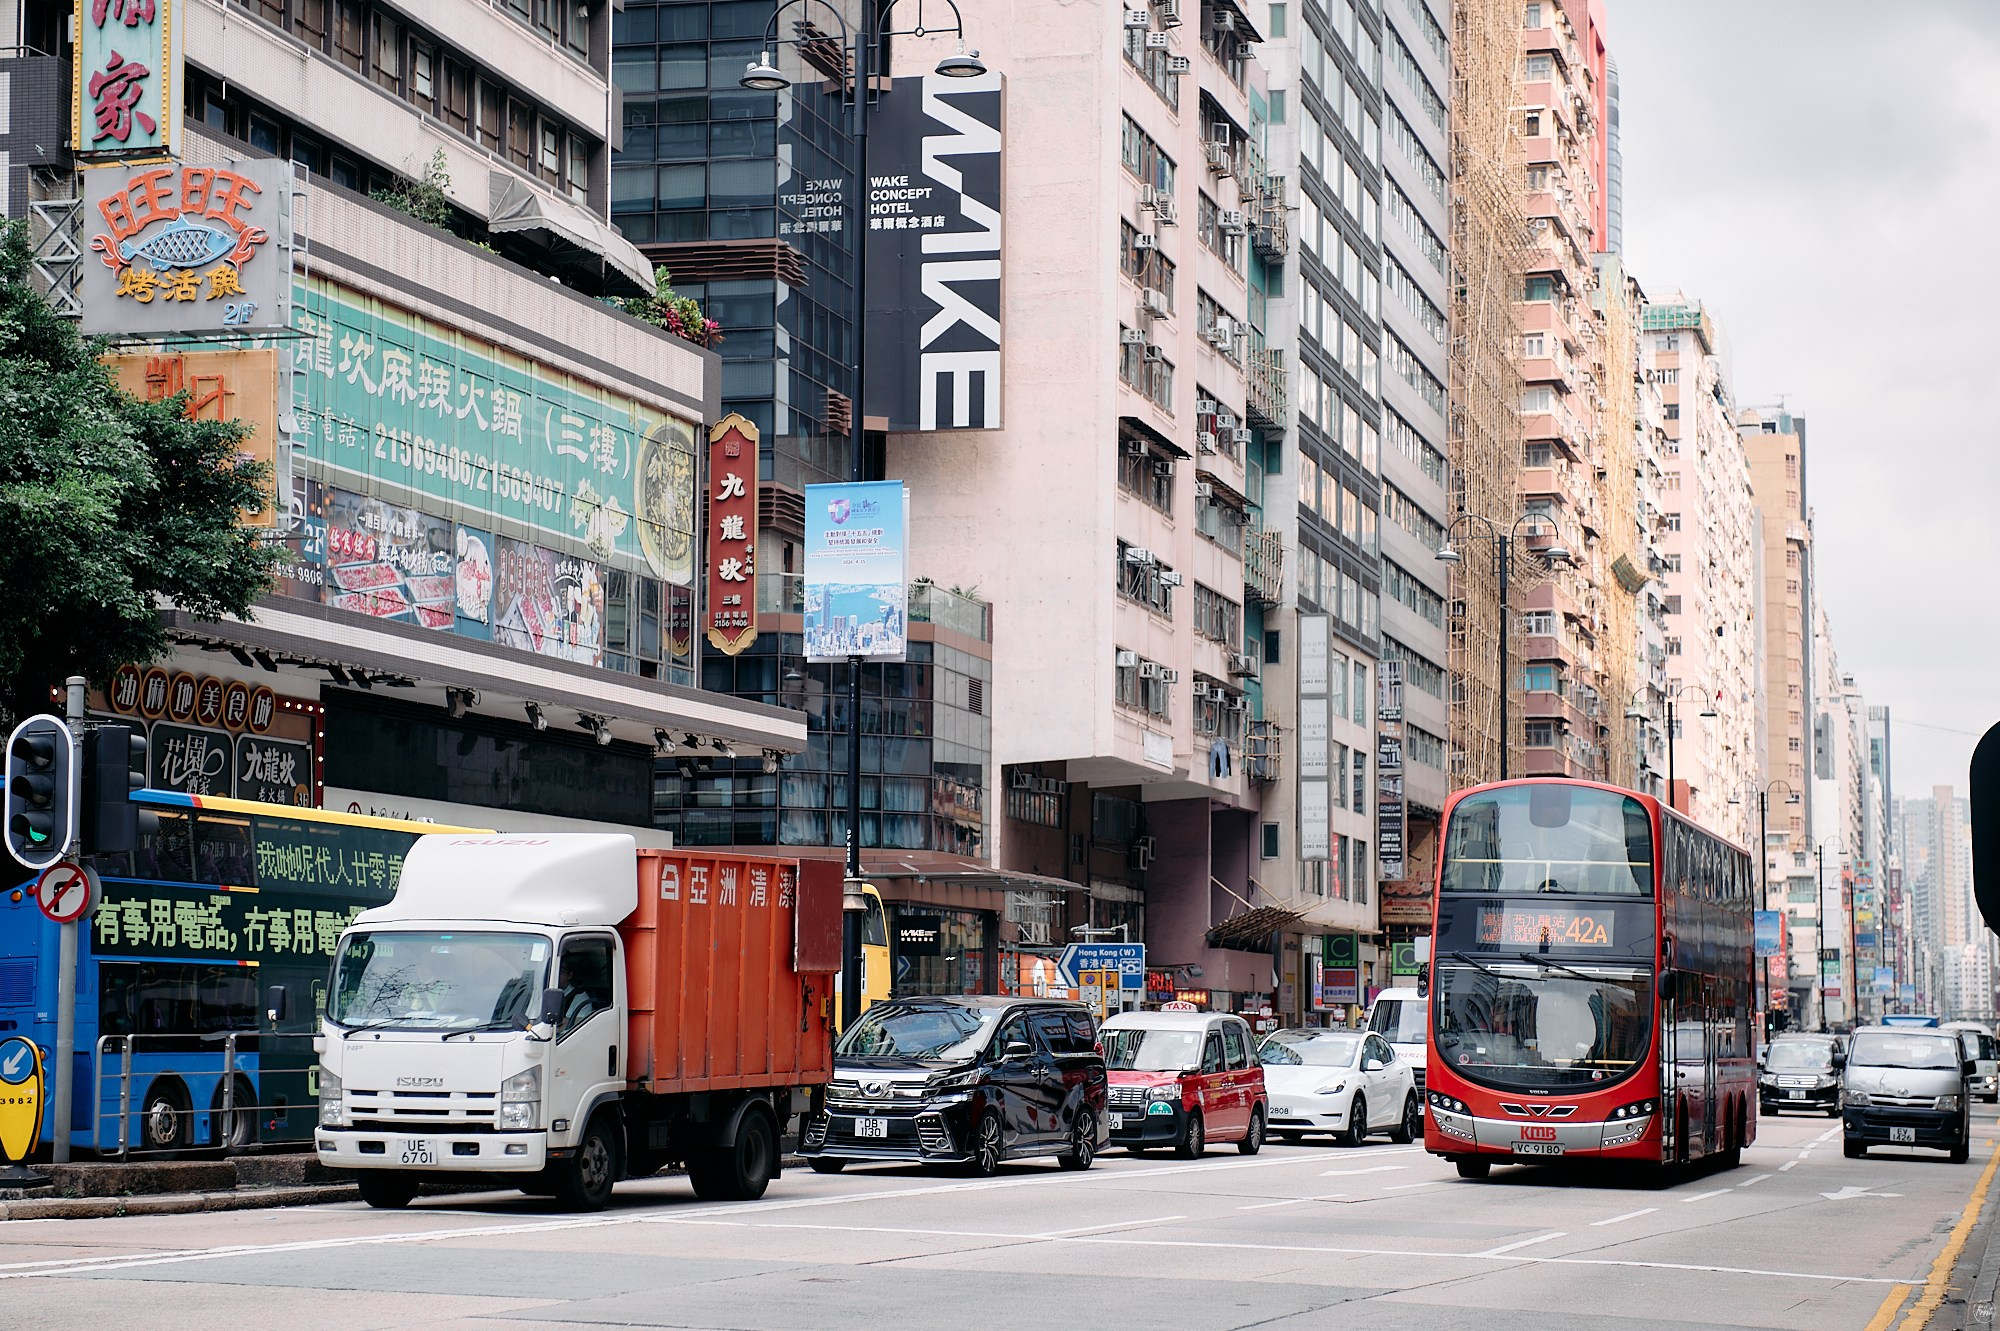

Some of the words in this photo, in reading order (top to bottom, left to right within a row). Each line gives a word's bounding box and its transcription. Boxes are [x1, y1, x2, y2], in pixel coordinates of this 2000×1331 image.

[871, 176, 908, 187] WAKE
[870, 188, 932, 201] CONCEPT
[98, 167, 262, 241] 旺旺
[870, 203, 913, 215] HOTEL
[870, 215, 946, 230] 華爾概念酒店
[920, 73, 1001, 430] WAKE
[115, 265, 247, 303] 烤活魚
[715, 472, 747, 582] 九龍坎
[303, 523, 327, 555] 2F
[714, 619, 731, 628] 2156
[731, 619, 748, 628] 9406
[117, 672, 271, 727] 油麻地美食城
[160, 733, 225, 786] 花園
[241, 742, 297, 788] 九龍坎
[257, 787, 287, 804] 老火鍋
[449, 838, 552, 847] ISUZU
[257, 840, 402, 890] 我哋呢代人廿零歲
[689, 866, 795, 909] 亞洲清潔
[1513, 925, 1538, 936] SPEED
[1541, 927, 1558, 937] RAIL
[1565, 916, 1608, 944] 42A
[1078, 949, 1098, 959] Hong
[1099, 949, 1118, 959] Kong
[1119, 948, 1135, 957] (W)
[1079, 958, 1118, 969] 香港(西)
[1166, 1002, 1192, 1011] TAXI
[396, 1076, 444, 1087] ISUZU
[861, 1127, 881, 1137] 1130
[1520, 1125, 1557, 1141] KMB
[406, 1139, 426, 1152] UE
[1516, 1144, 1530, 1153] VC
[1533, 1145, 1561, 1155] 9180
[401, 1152, 433, 1164] 6701
